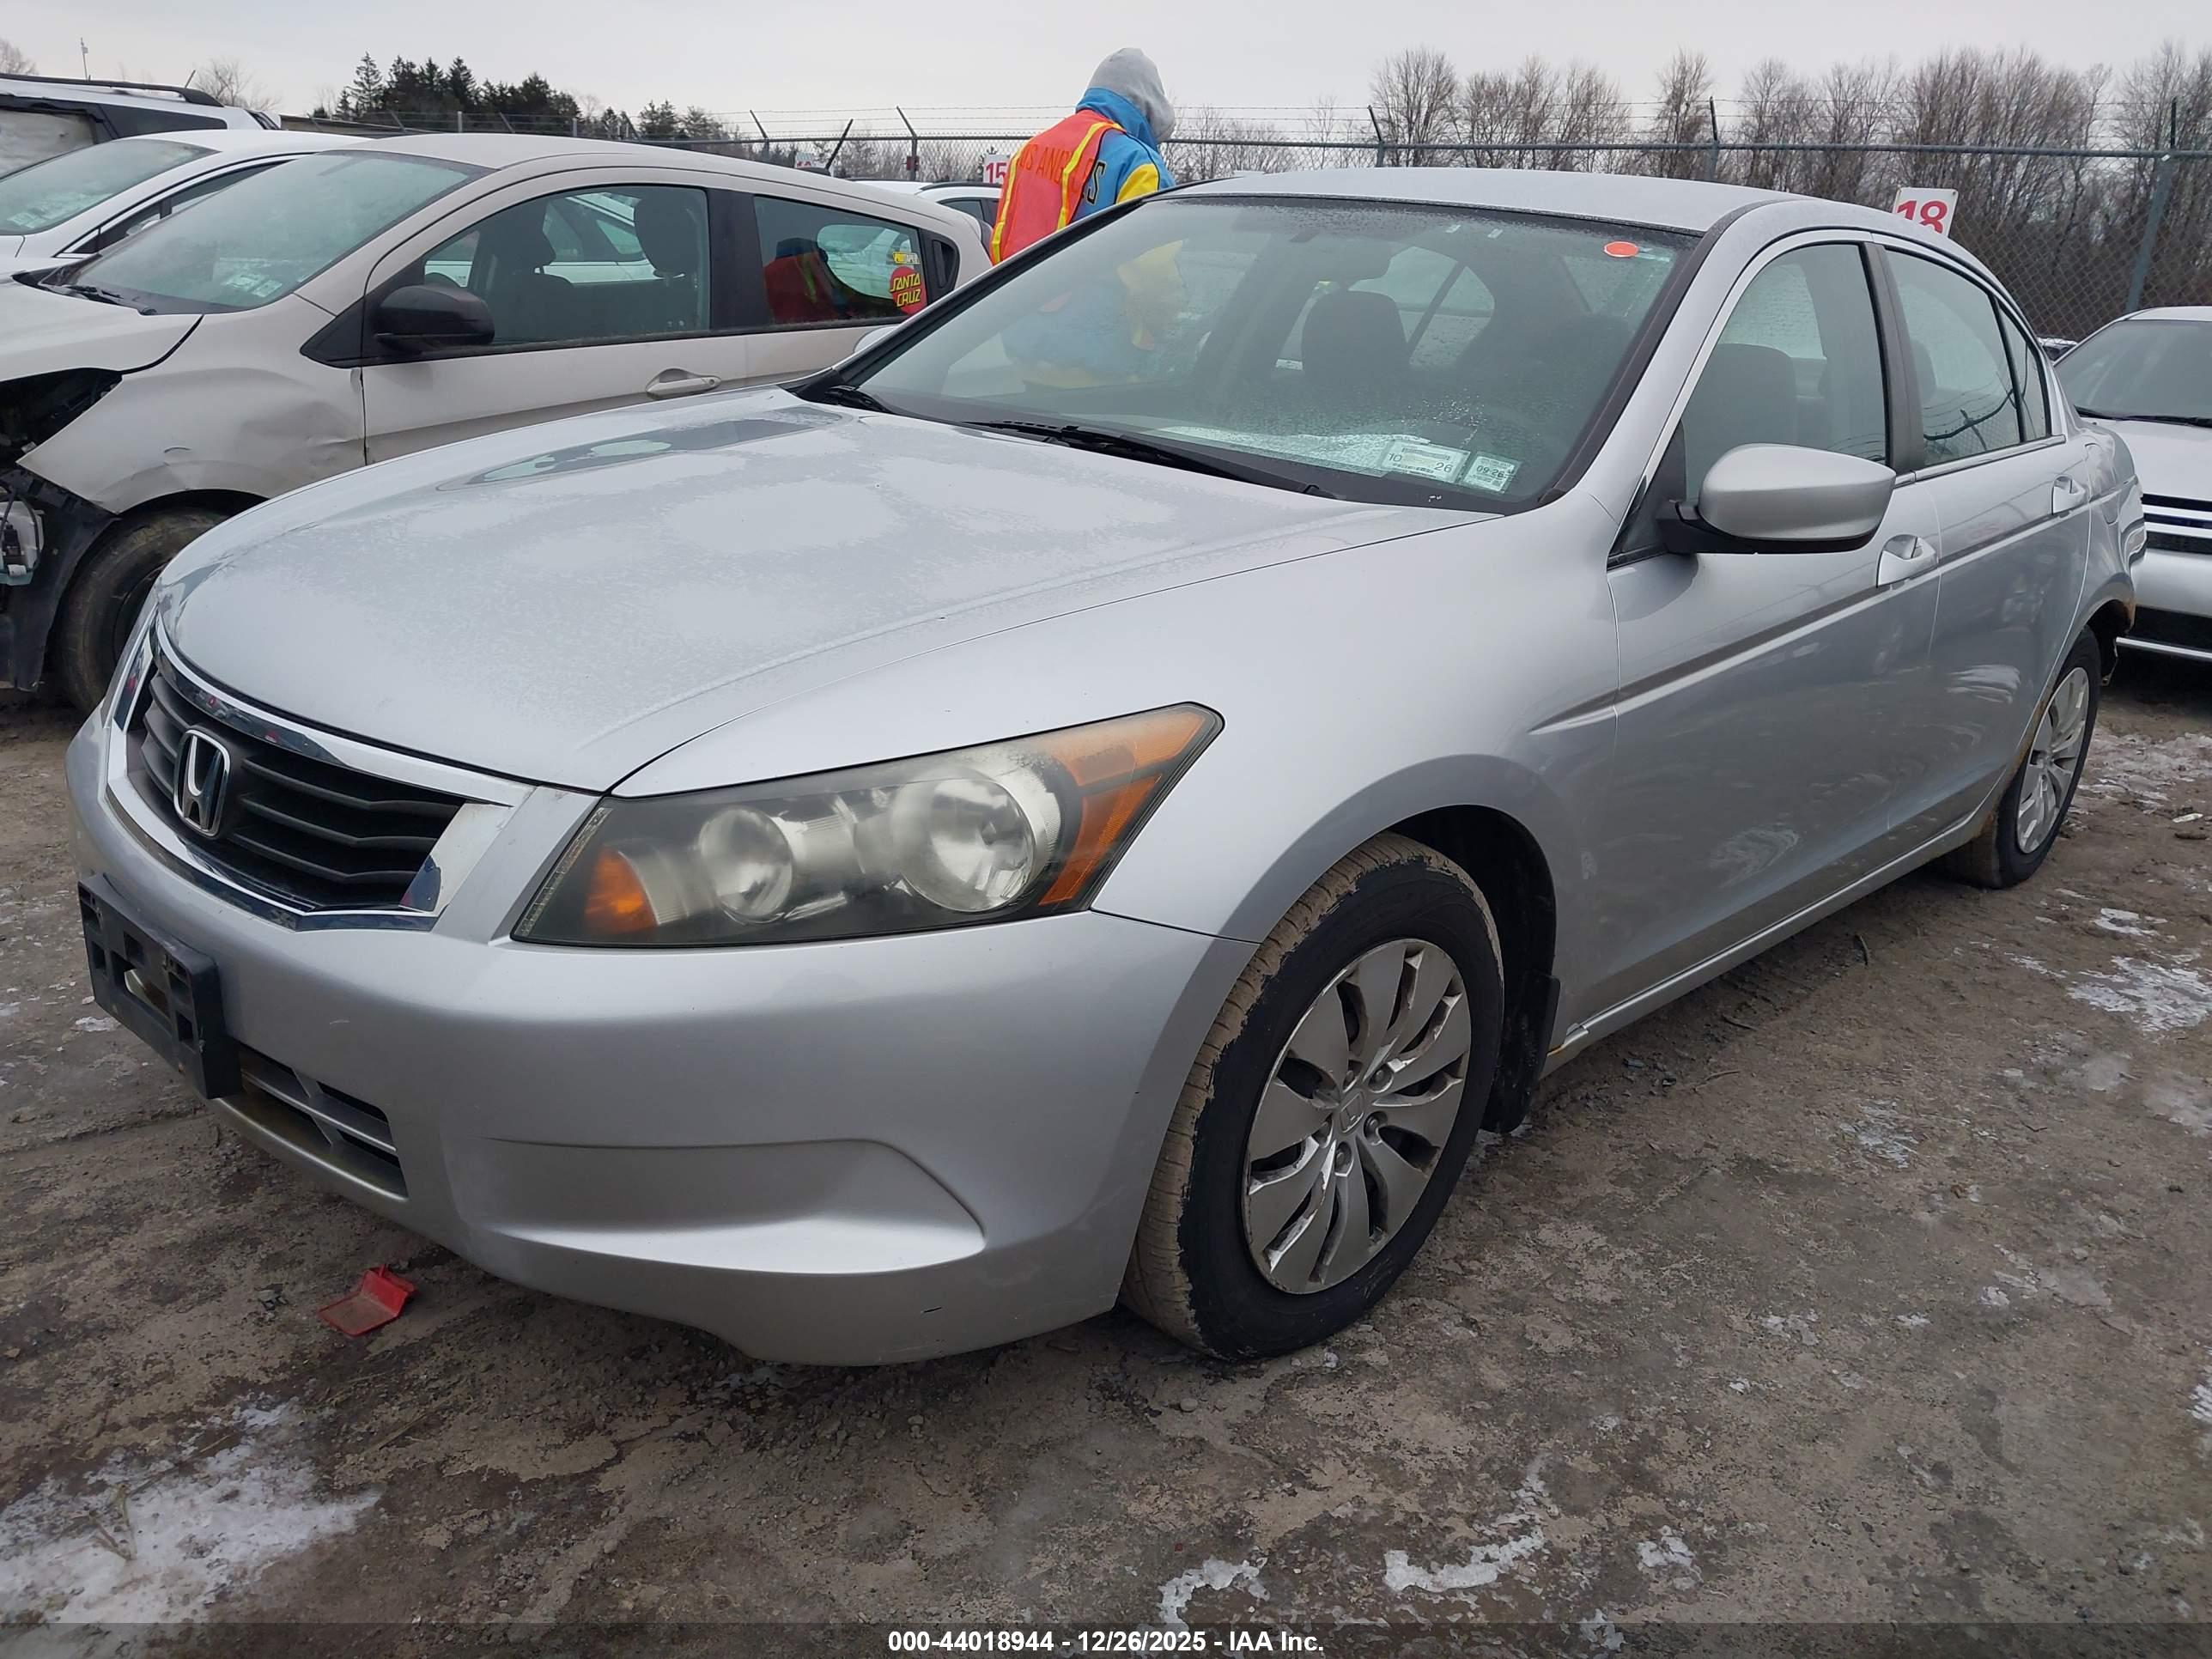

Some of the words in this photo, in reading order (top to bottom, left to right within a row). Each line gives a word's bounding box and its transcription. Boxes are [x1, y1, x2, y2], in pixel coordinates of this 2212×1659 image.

[985, 161, 1007, 184] 15
[1896, 199, 1948, 234] 18
[890, 272, 921, 293] SANTA
[896, 288, 921, 307] CRUZ
[1389, 453, 1403, 463] 10
[1434, 461, 1454, 474] 26
